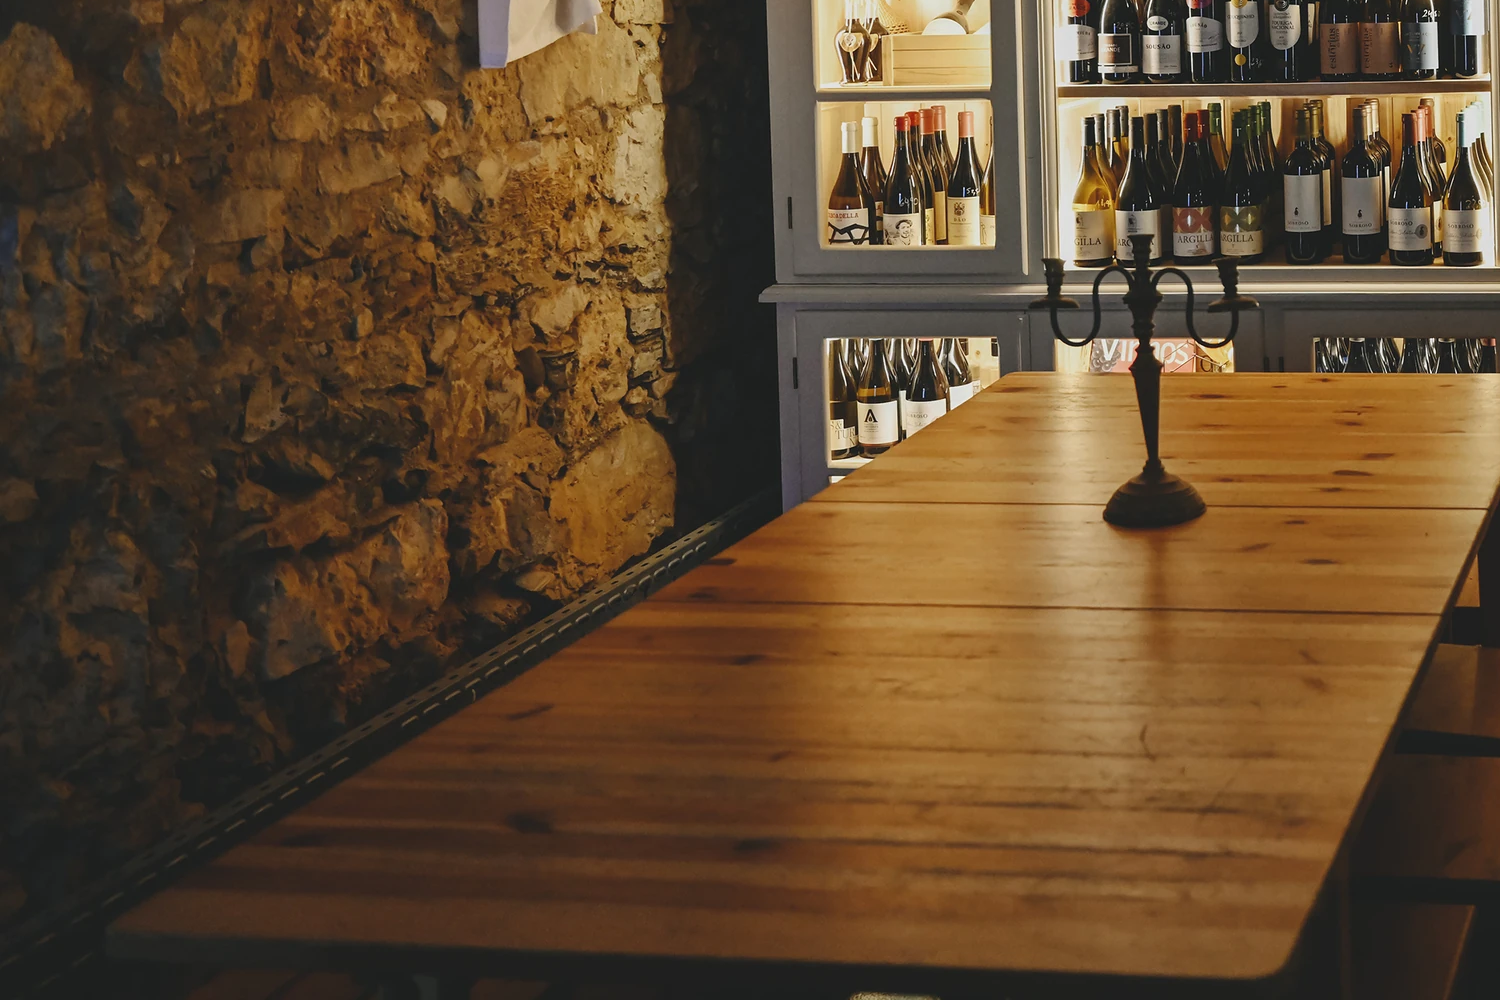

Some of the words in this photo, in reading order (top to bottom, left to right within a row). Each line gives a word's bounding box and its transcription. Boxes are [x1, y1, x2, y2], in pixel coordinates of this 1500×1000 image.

[1074, 237, 1102, 246] GILLA
[1117, 237, 1154, 247] ARGA
[1177, 234, 1214, 244] ARGILLA
[1220, 233, 1254, 243] ARGILLA
